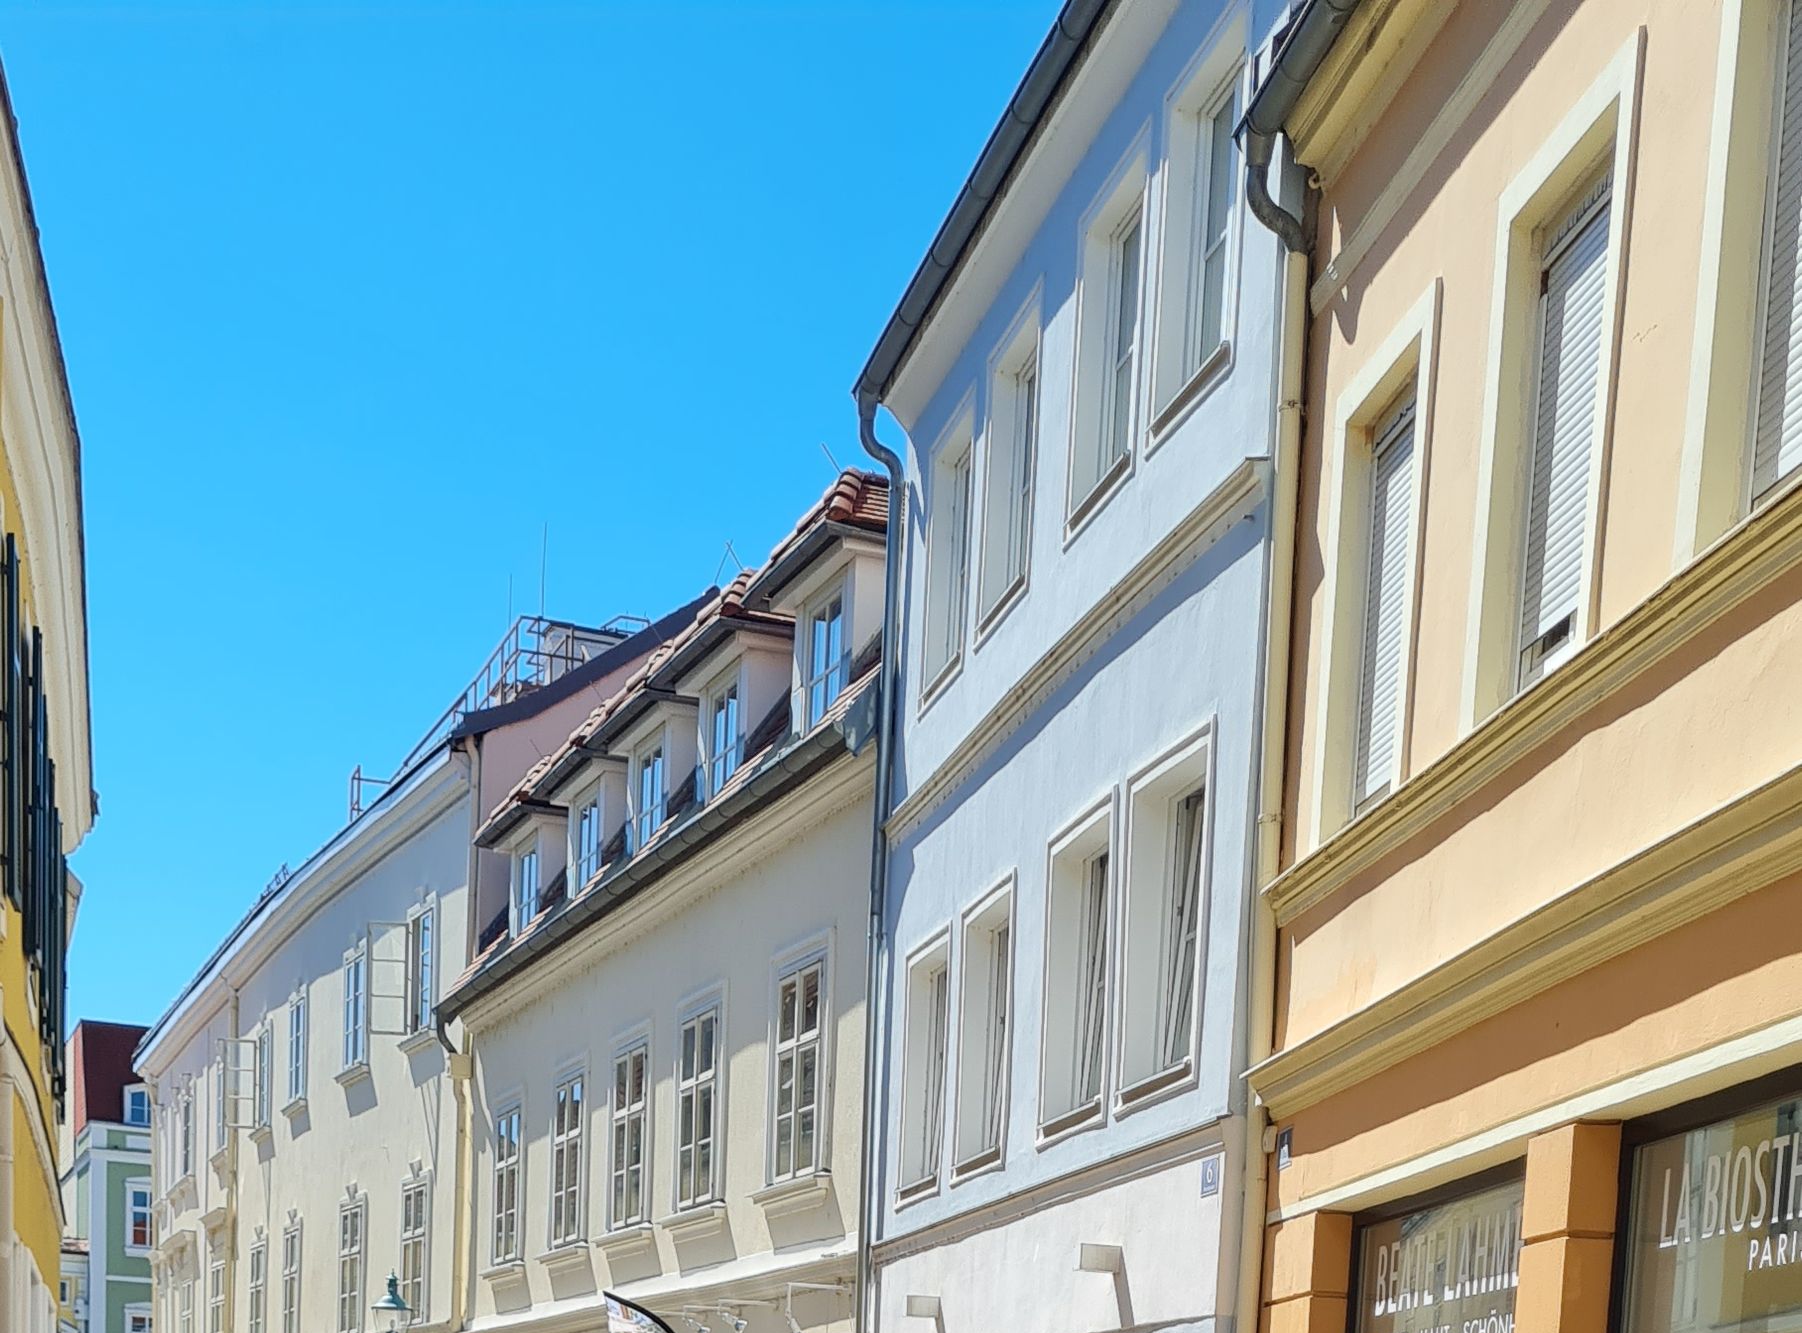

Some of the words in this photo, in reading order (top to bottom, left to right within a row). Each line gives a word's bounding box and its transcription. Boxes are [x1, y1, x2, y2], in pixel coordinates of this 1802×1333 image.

[1659, 1162, 1692, 1249] LA
[1374, 1230, 1436, 1317] BEATE
[1748, 1230, 1802, 1272] PARI
